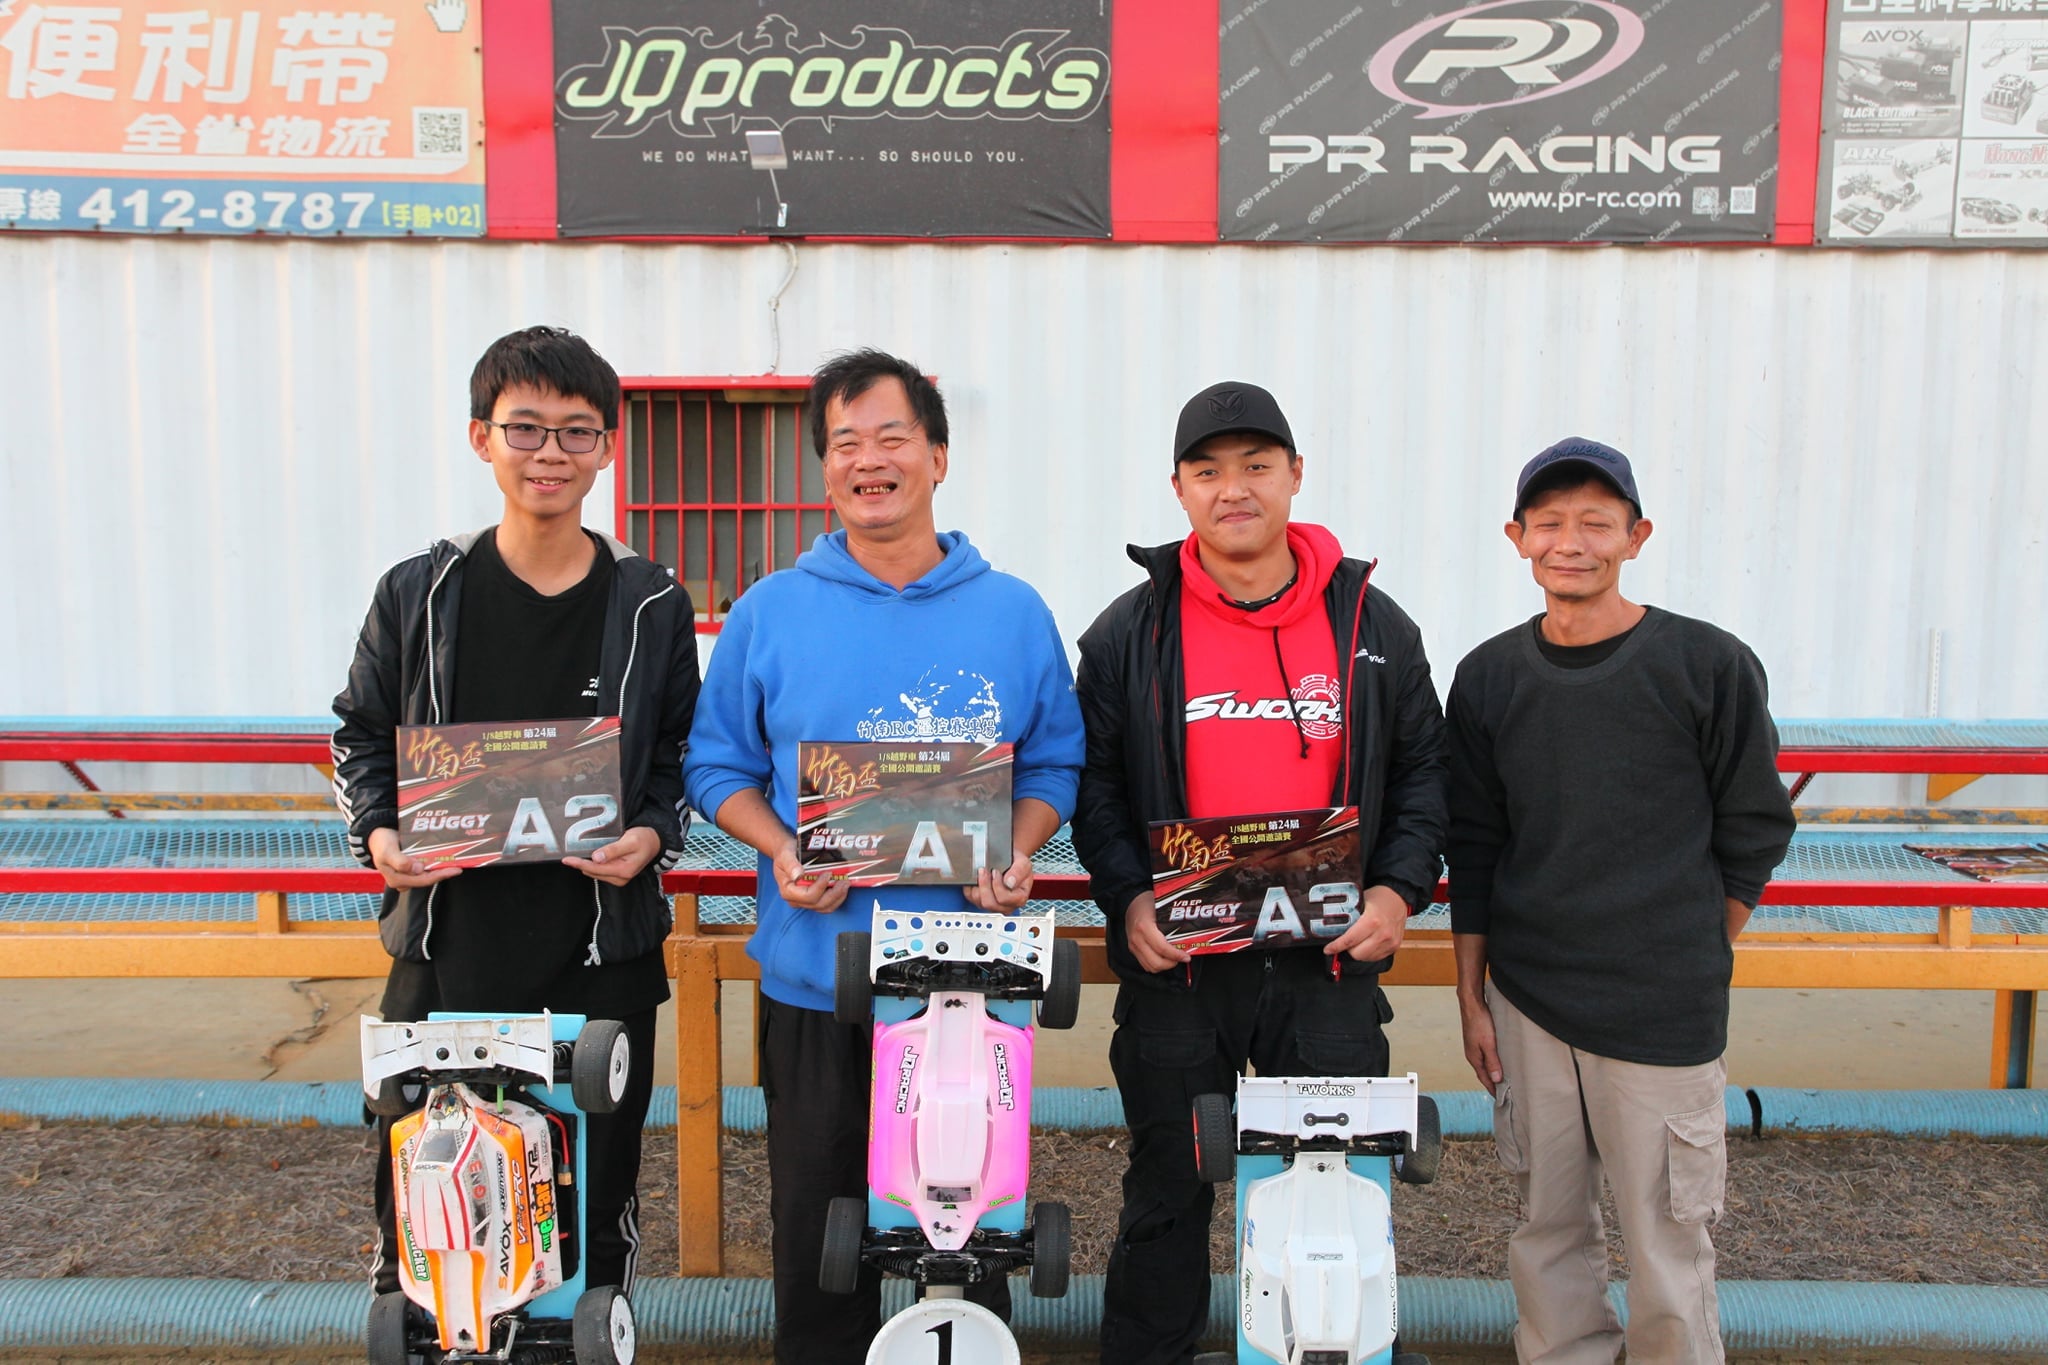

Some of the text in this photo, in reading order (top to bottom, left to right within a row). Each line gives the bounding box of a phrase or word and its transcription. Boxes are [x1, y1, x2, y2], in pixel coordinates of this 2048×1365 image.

[0, 5, 396, 106] 便利帶
[1843, 107, 1875, 118] BLACK
[122, 113, 391, 157] 全省物流
[1269, 135, 1722, 174] PR RACING
[642, 151, 664, 163] WE
[675, 151, 695, 162] DO
[706, 150, 749, 162] WHAT
[879, 150, 899, 162] SO
[911, 151, 973, 163] SHOULD
[985, 151, 1025, 162] YOU.
[78, 188, 375, 230] 412-8787
[1488, 191, 1681, 213] www.pr-rc.com
[411, 814, 492, 832] BUGGY
[501, 794, 619, 856] A2
[808, 835, 886, 850] BUGGY
[900, 821, 988, 879] A1
[1169, 903, 1243, 921] BUGGY
[1251, 882, 1360, 943] A3
